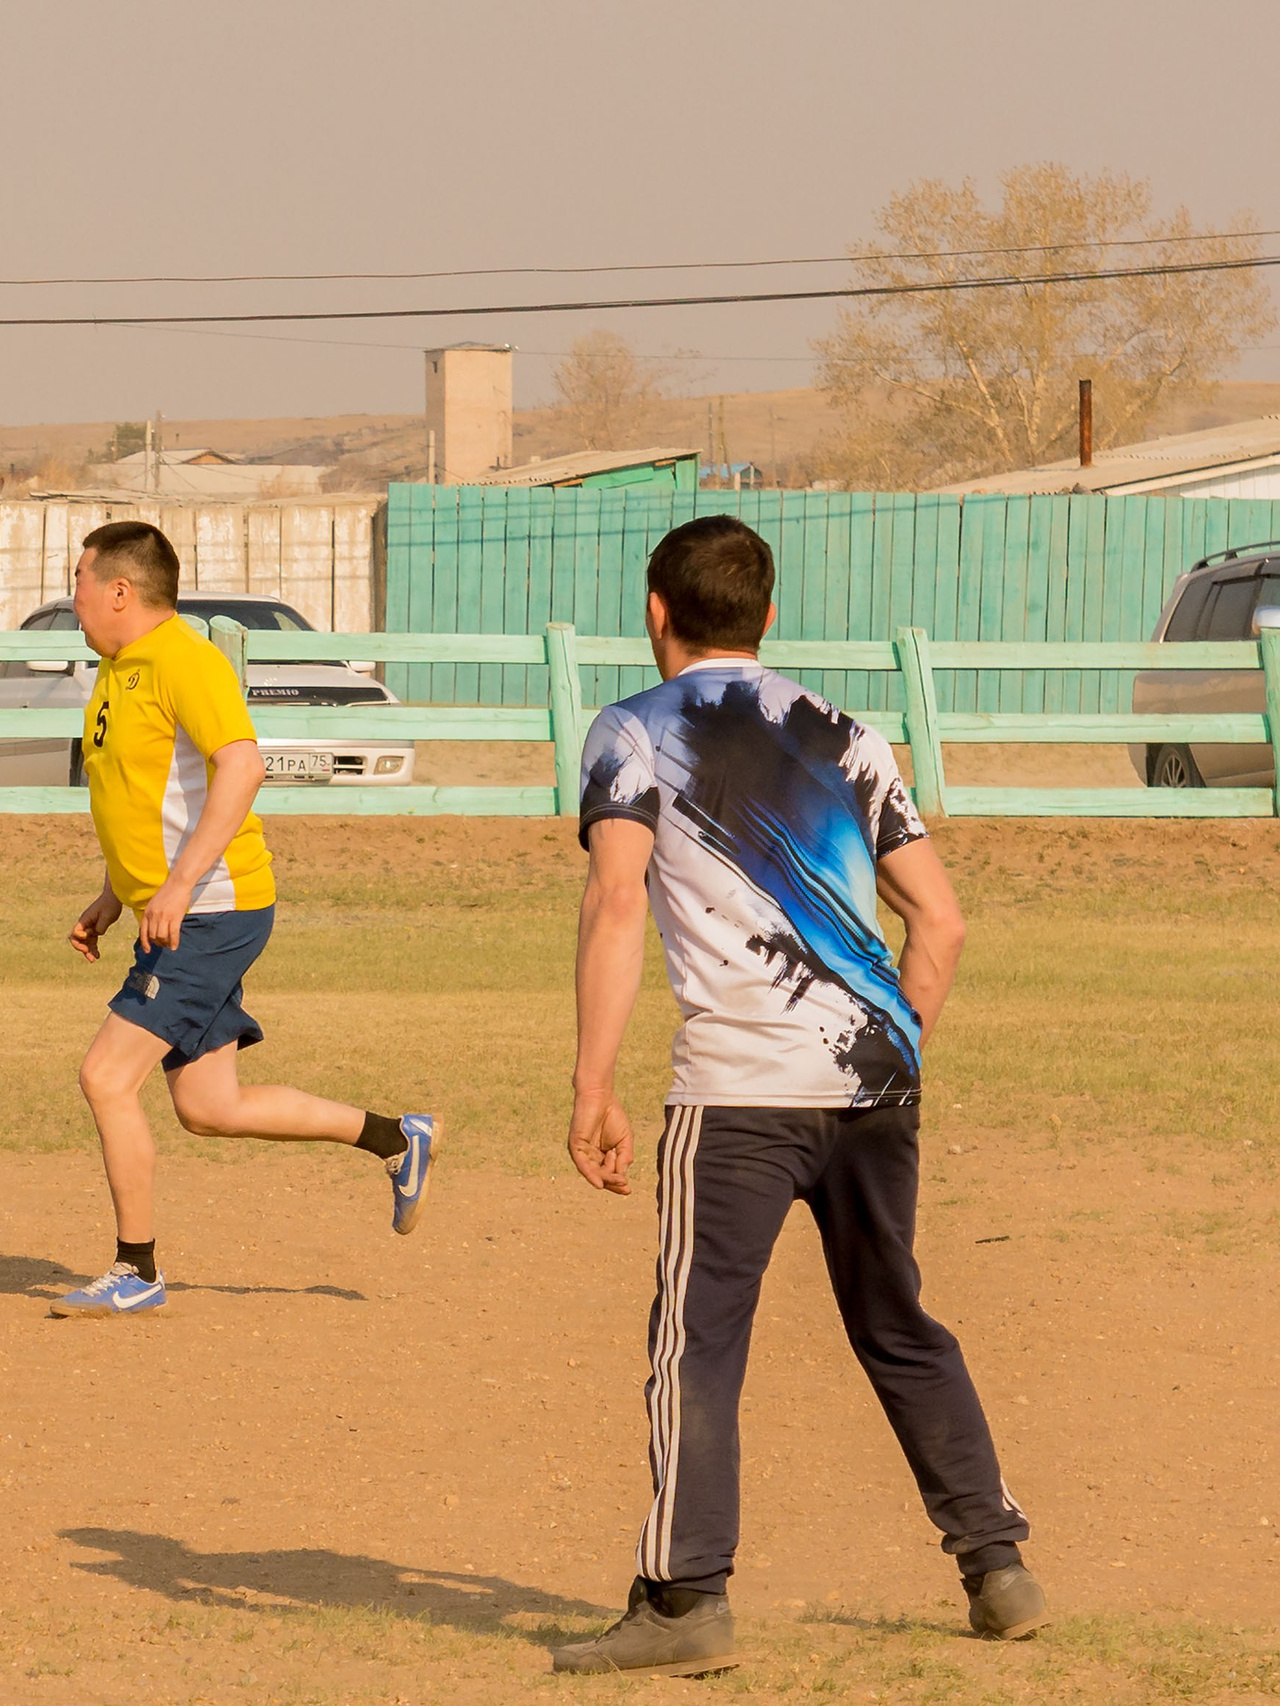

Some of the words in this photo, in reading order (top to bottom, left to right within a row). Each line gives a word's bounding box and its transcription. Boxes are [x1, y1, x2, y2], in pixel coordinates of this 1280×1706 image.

[251, 688, 300, 697] PREMIO
[93, 701, 110, 748] 5
[265, 756, 306, 771] 21РА
